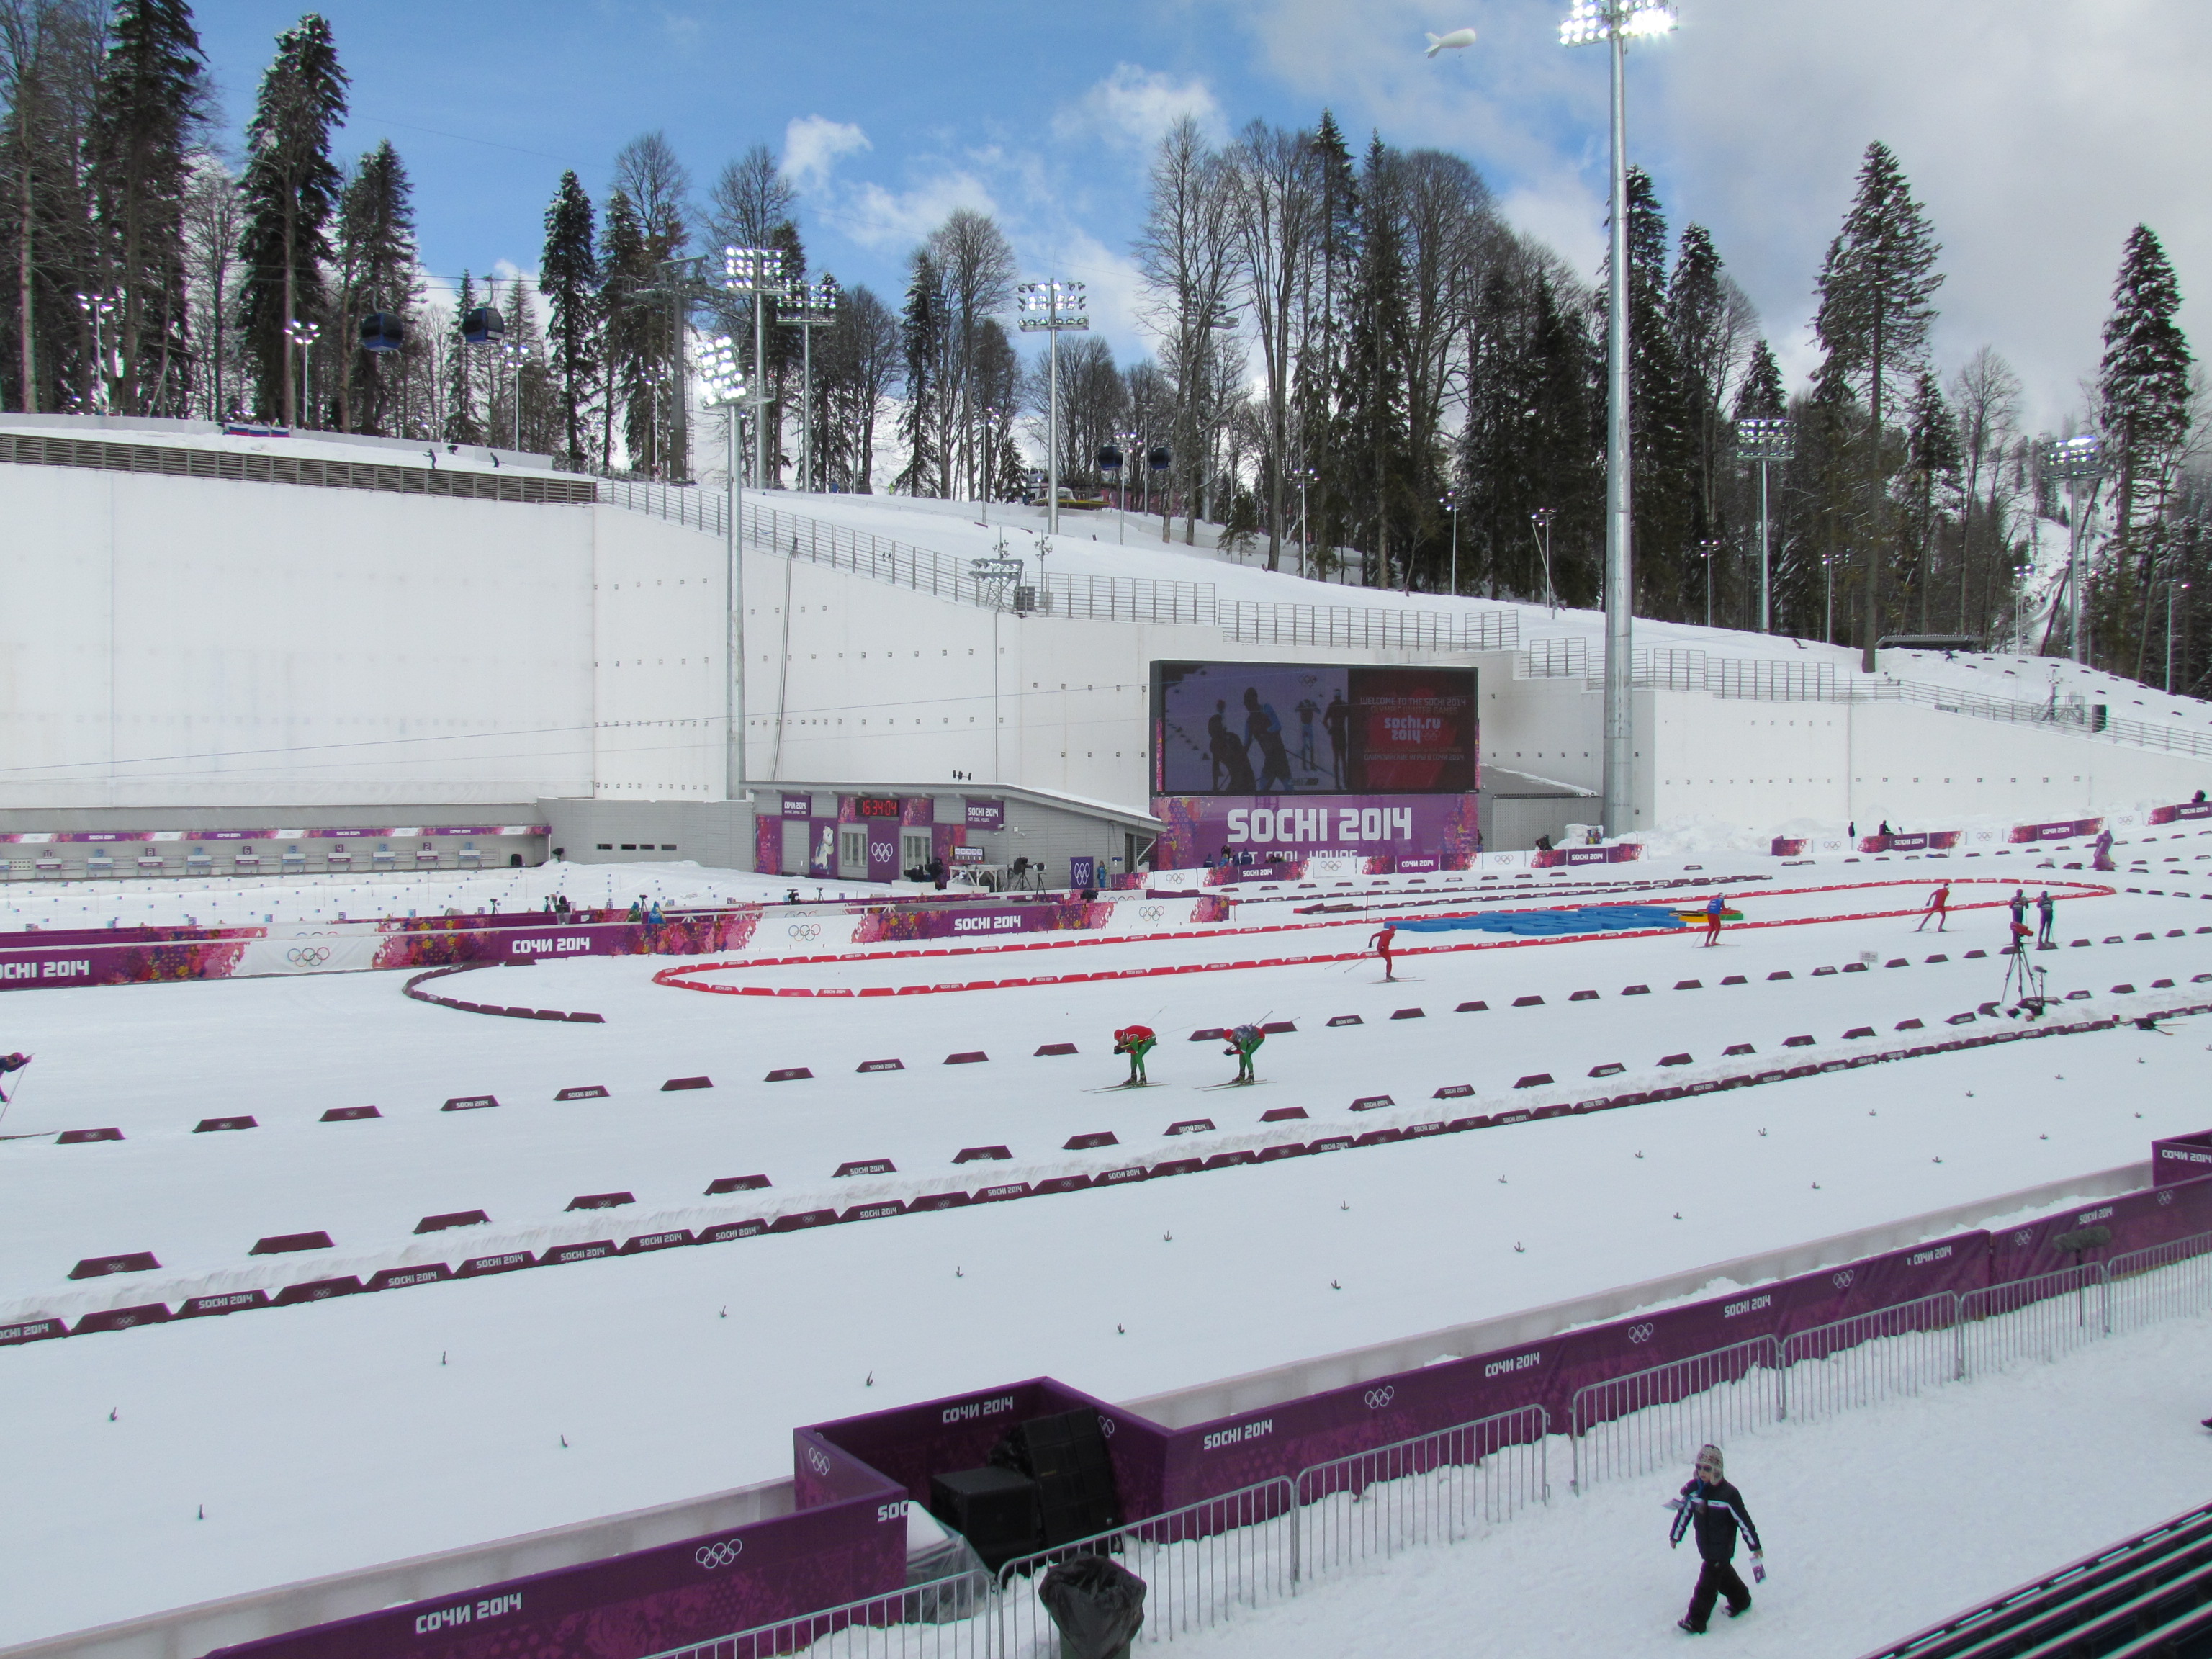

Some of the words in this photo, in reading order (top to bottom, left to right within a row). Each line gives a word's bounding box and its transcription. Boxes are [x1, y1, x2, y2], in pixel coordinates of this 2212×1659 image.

[1447, 698, 1466, 706] 2014
[1384, 715, 1441, 729] sochi.ru
[862, 800, 896, 815] 16:34:04
[968, 807, 984, 816] SOCHI
[985, 808, 999, 817] 2014
[1228, 809, 1328, 842] SOCHI
[1339, 808, 1411, 840] 2014
[954, 917, 990, 930] SOCHI
[994, 915, 1020, 928] 2014
[513, 939, 552, 953] СОЧИ
[557, 937, 590, 951] 2014
[0, 963, 37, 979] CHI
[44, 960, 89, 977] 2014
[2162, 1150, 2188, 1160] СОЧИ
[2190, 1153, 2212, 1163] 2014
[850, 1165, 868, 1174] SOCHI
[870, 1164, 884, 1172] 2014
[988, 1188, 1006, 1197] SOCHI
[1007, 1185, 1022, 1194] 2014
[860, 1210, 881, 1218] SOCHI
[2078, 1211, 2097, 1225] SOCHI
[2098, 1207, 2113, 1220] 2014
[639, 1236, 663, 1246] SOCHI
[665, 1233, 682, 1243] 2014
[716, 1230, 737, 1240] SOCHI
[739, 1227, 756, 1236] 2014
[477, 1257, 501, 1269] SOCHI
[503, 1254, 523, 1265] 2014
[560, 1250, 585, 1262] SOCHI
[586, 1247, 605, 1258] 2014
[1914, 1251, 1933, 1264] СОЧИ
[1935, 1246, 1951, 1259] 2014
[389, 1275, 415, 1286] SOCHI
[417, 1272, 437, 1282] 2014
[199, 1296, 228, 1309] SOCHI
[230, 1293, 253, 1305] 2014
[1725, 1300, 1748, 1318] SOCHI
[1751, 1295, 1771, 1310] 2014
[22, 1322, 49, 1336] 2014
[1485, 1359, 1514, 1377] СОЧИ
[1516, 1352, 1539, 1369] 2014
[943, 1403, 979, 1423] СОЧИ
[984, 1396, 1013, 1415] 2014
[1204, 1425, 1241, 1450] SOCHI
[1244, 1419, 1272, 1439] 2014
[416, 1605, 470, 1633] СОЧИ
[477, 1593, 521, 1619] 2014
